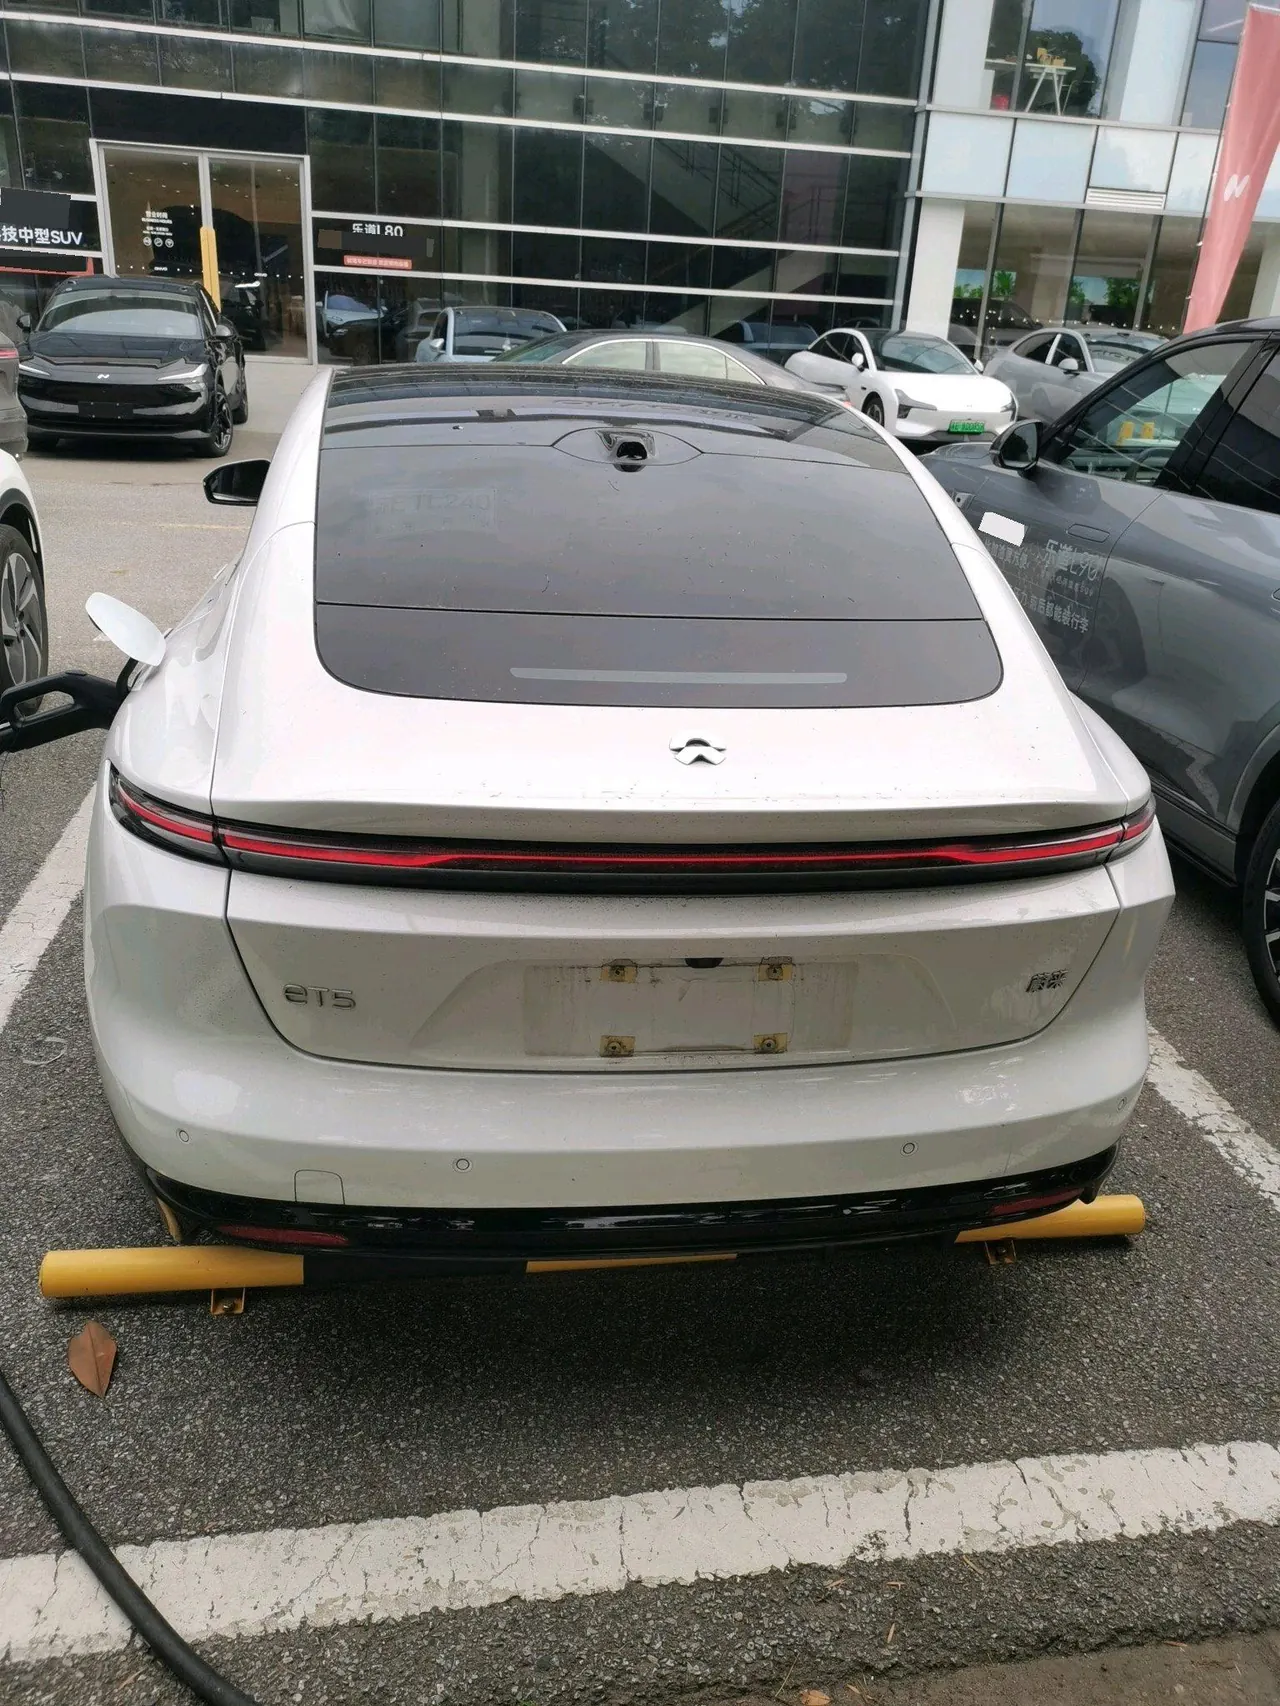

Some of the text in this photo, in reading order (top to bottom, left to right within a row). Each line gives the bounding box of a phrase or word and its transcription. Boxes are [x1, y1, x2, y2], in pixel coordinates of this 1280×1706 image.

[0, 225, 82, 245] 技中型SUV
[1025, 968, 1069, 993] 蔚来
